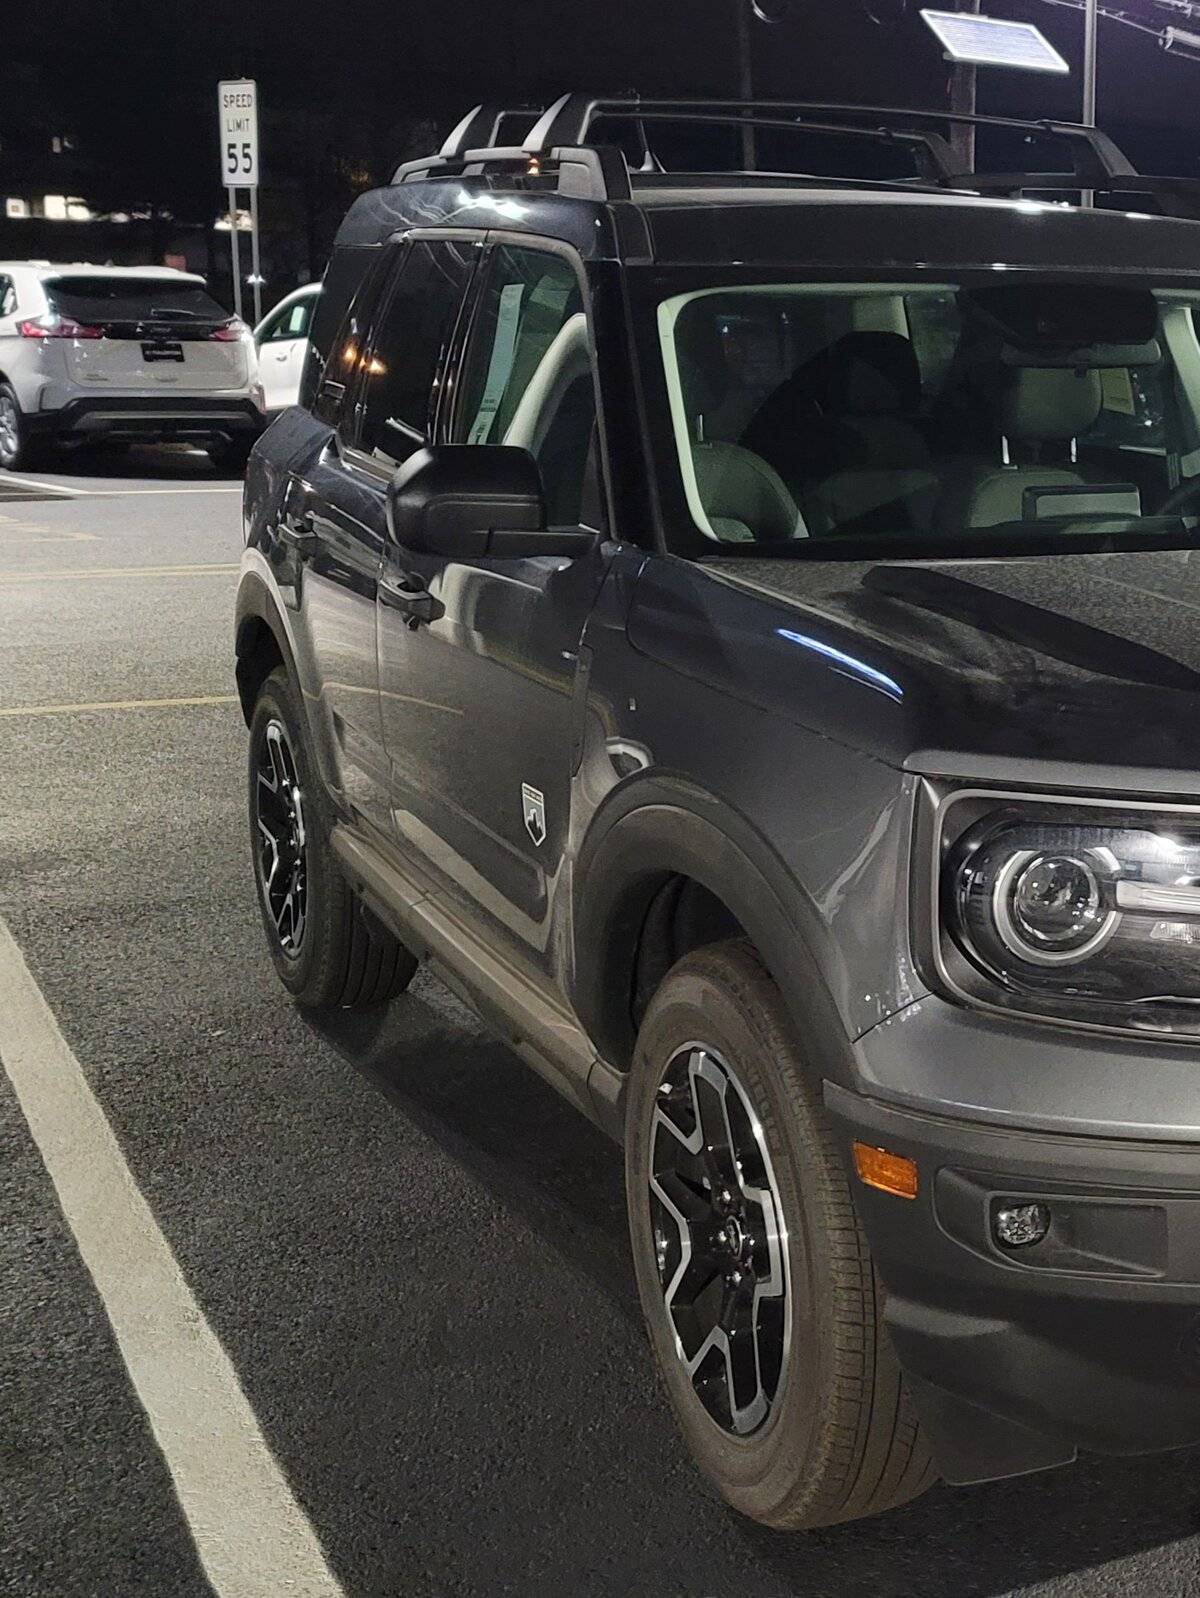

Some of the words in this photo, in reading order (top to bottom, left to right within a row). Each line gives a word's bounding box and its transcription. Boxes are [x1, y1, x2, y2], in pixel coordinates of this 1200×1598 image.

[223, 93, 252, 109] SPEED
[227, 118, 250, 133] LIMIT
[227, 143, 252, 174] 55
